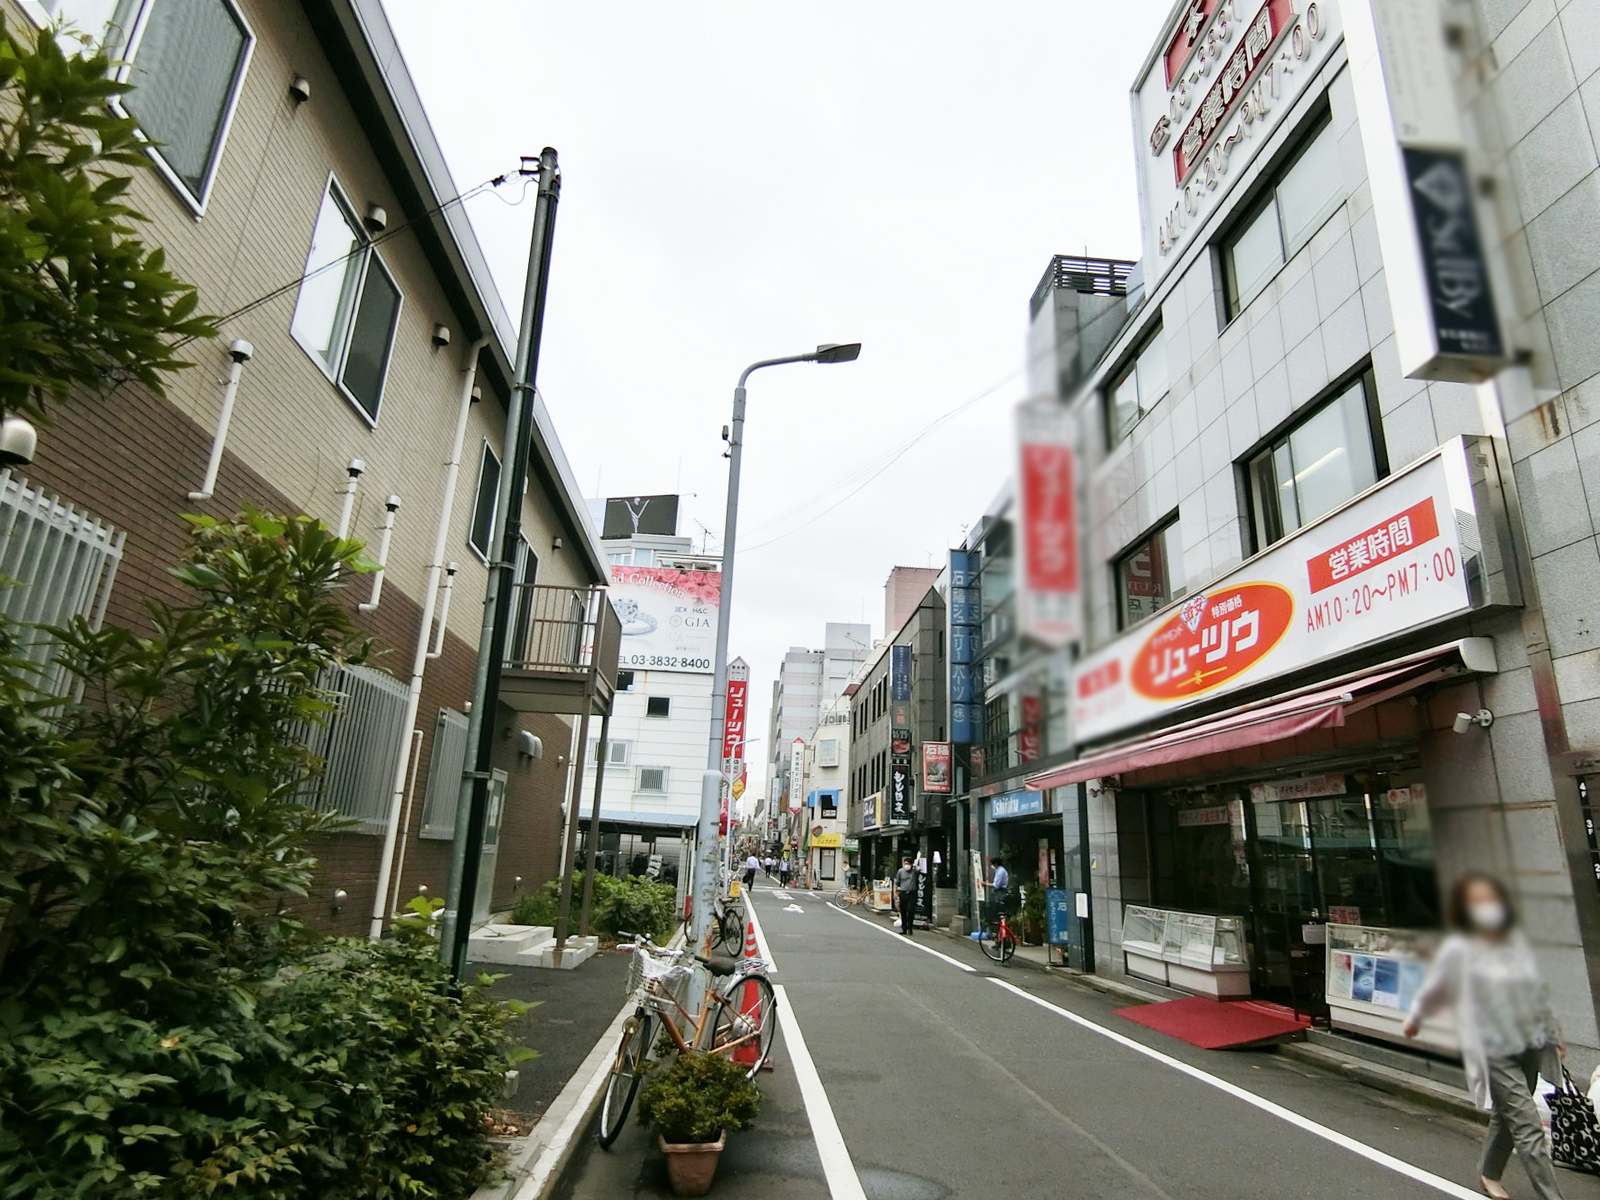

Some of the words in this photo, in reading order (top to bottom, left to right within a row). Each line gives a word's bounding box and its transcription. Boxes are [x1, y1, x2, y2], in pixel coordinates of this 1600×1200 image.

[1181, 6, 1273, 168] 営業時間
[1327, 515, 1413, 580] 営業時間
[629, 573, 686, 601] Collection
[1211, 594, 1242, 619] 特別価格
[684, 616, 711, 628] GIA
[631, 655, 710, 669] 03-3832-8400
[1152, 609, 1260, 686] リューツウ
[727, 687, 745, 746] リューツウ
